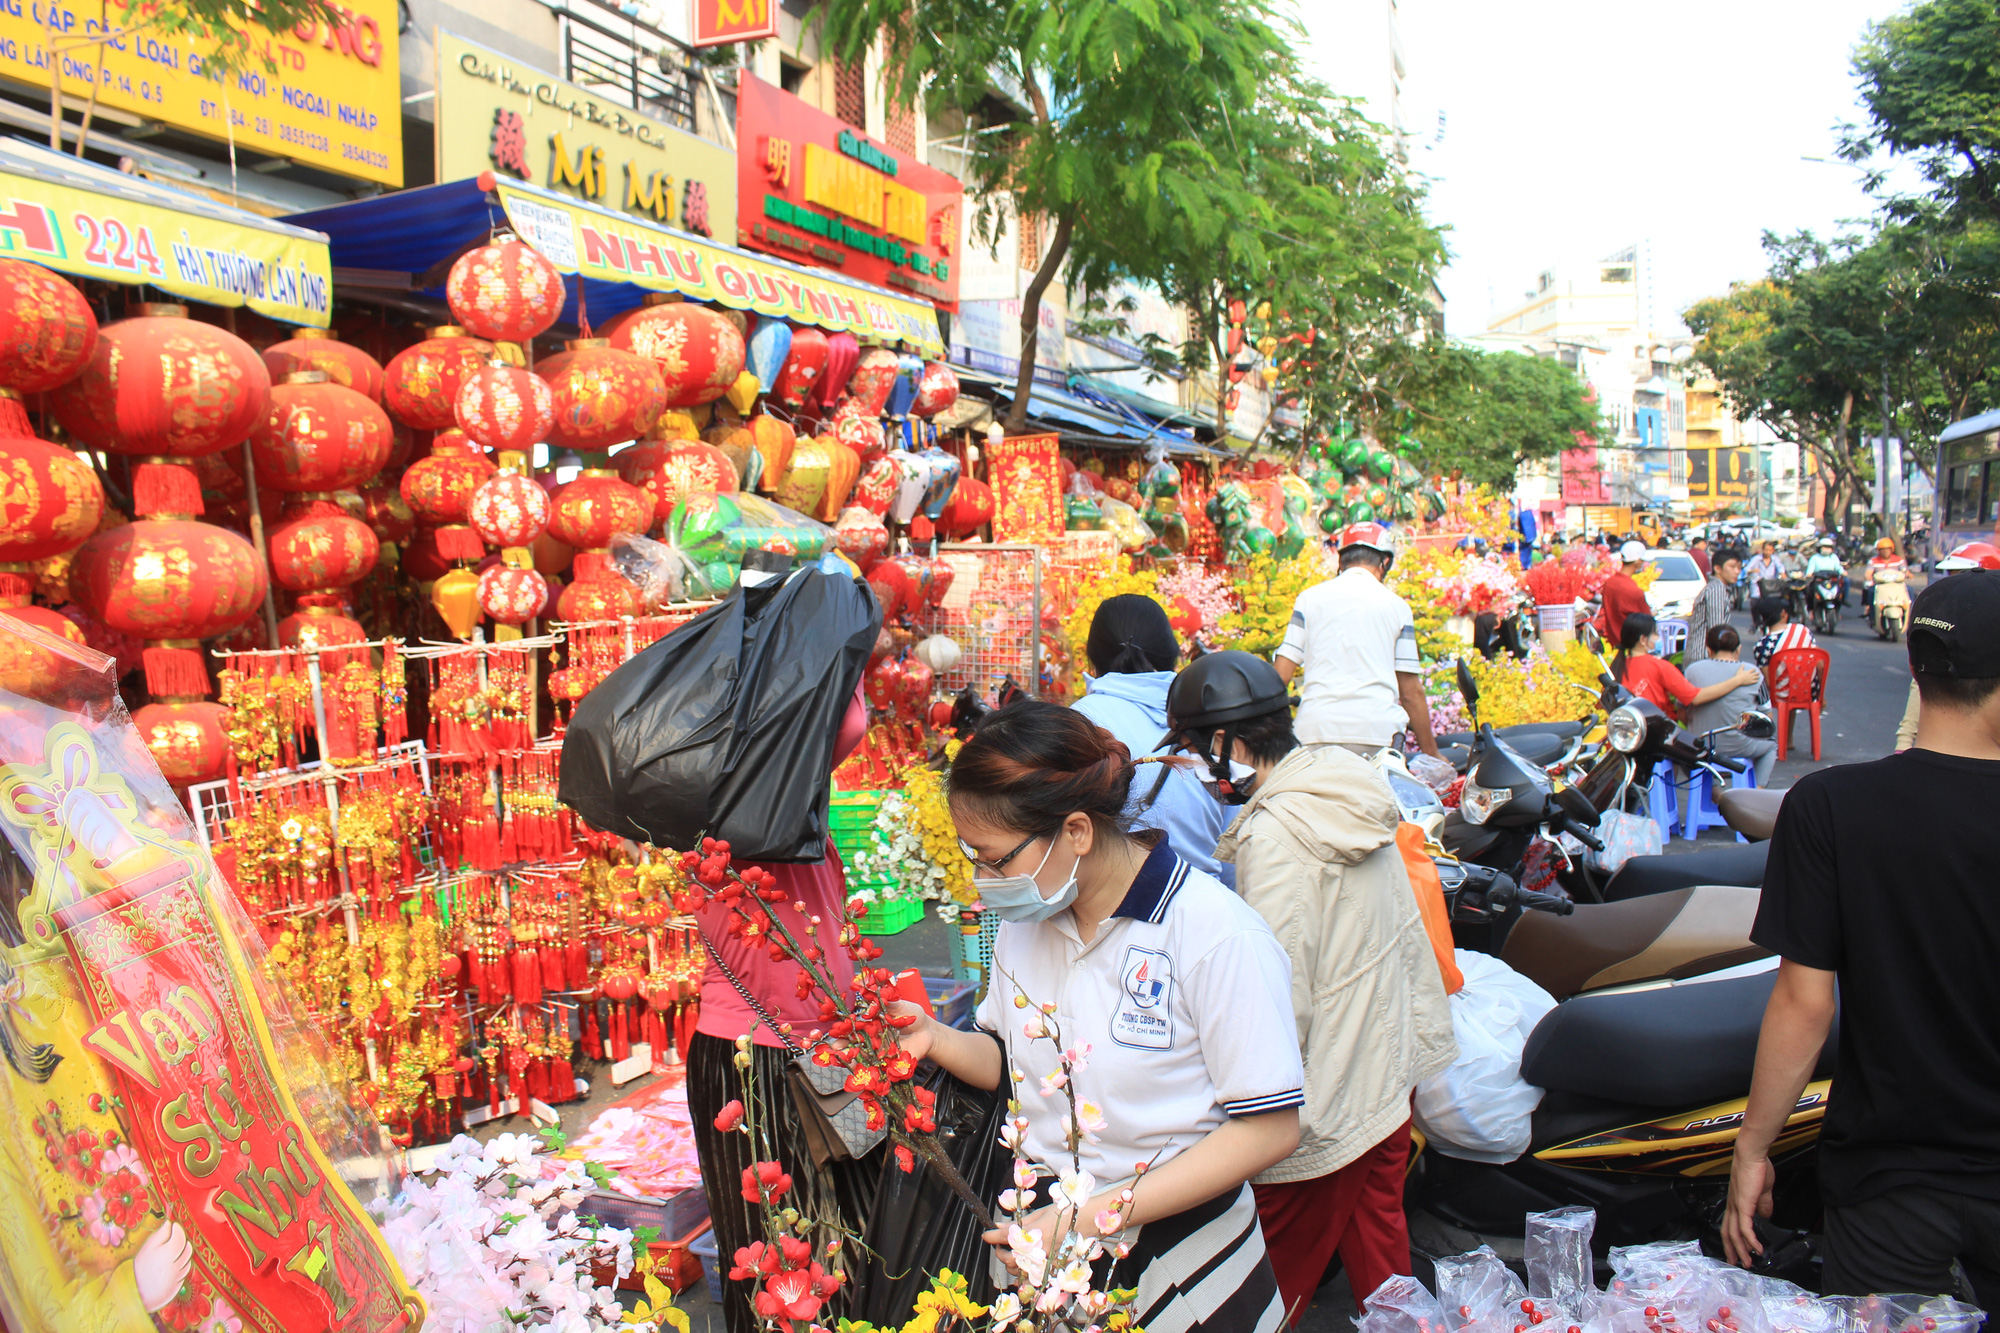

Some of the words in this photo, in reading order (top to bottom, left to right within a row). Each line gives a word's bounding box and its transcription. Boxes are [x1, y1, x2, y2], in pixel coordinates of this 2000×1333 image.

[74, 212, 163, 277] 224
[173, 231, 208, 285] HẢI
[300, 262, 327, 314] ÔNG
[581, 224, 702, 286] NHƯ
[715, 261, 866, 327] QUỲNH
[88, 985, 218, 1089] Vạn
[161, 1065, 256, 1178] Sự
[215, 1127, 320, 1269] Như
[284, 1219, 358, 1321] Ý
